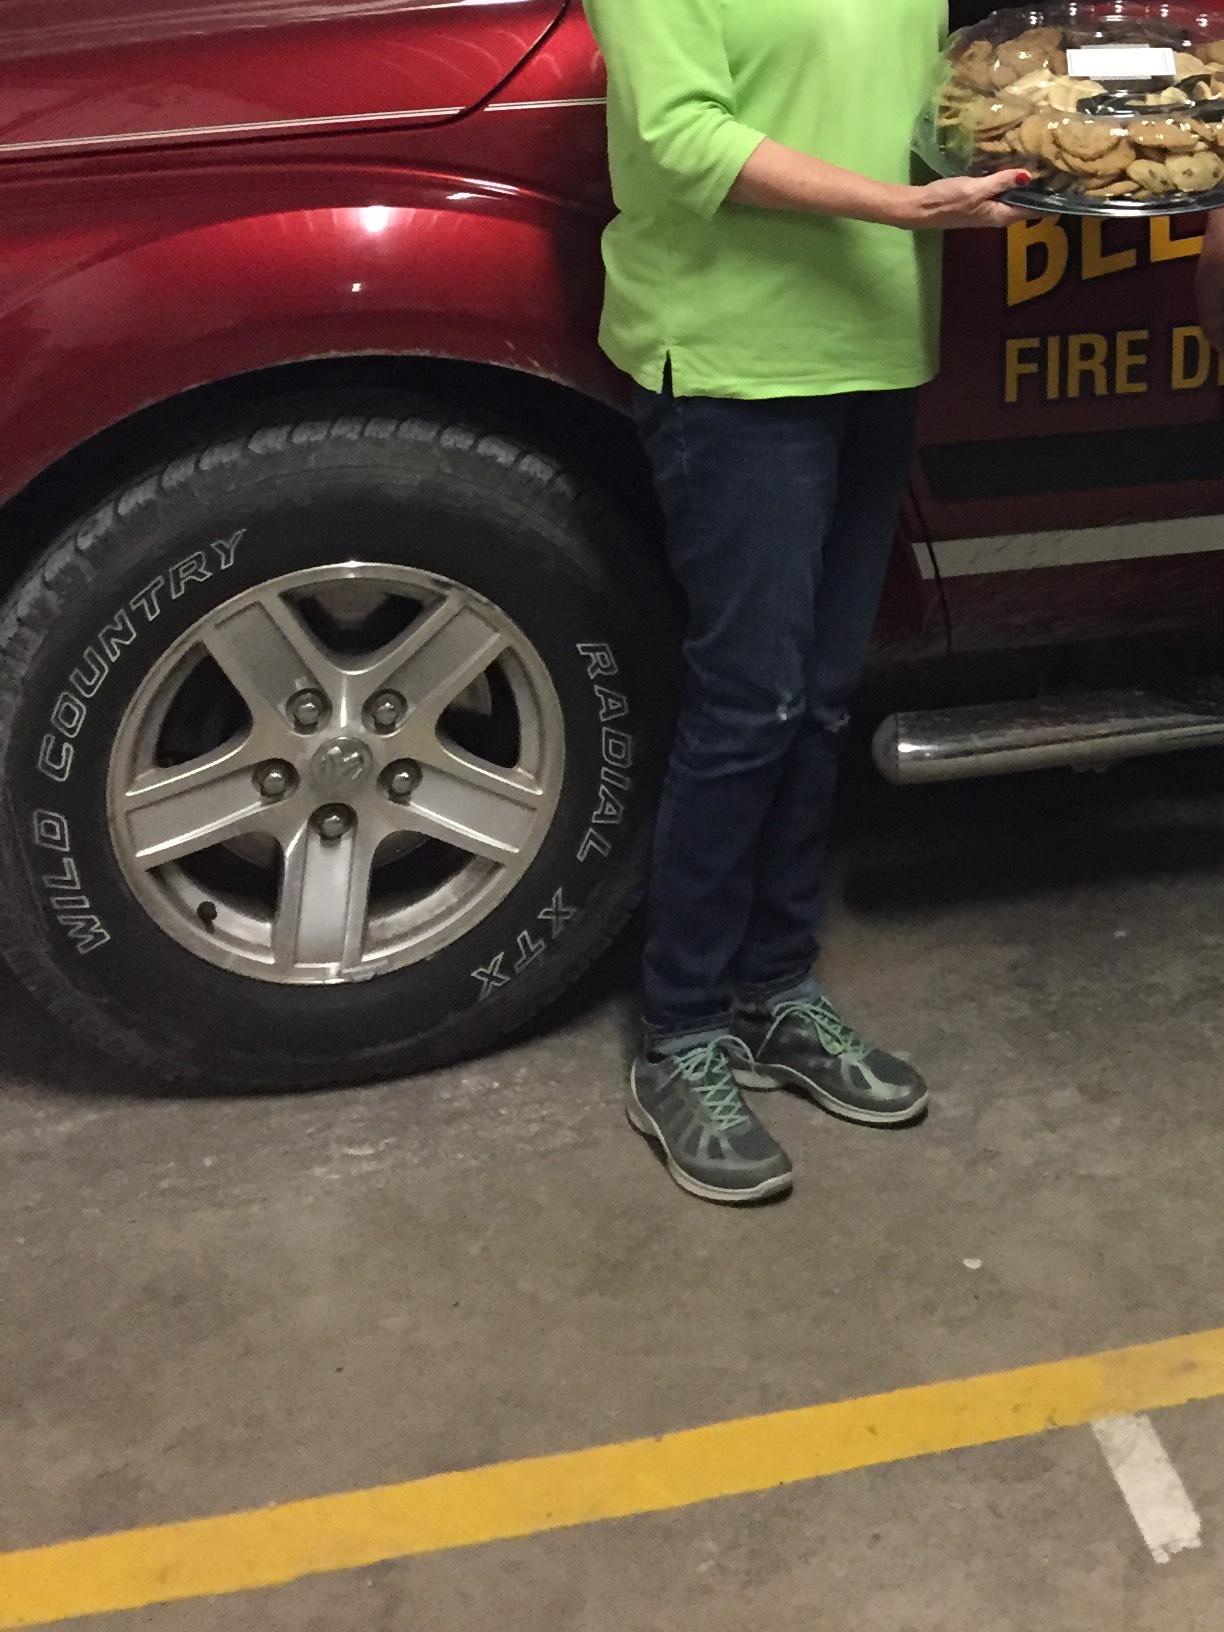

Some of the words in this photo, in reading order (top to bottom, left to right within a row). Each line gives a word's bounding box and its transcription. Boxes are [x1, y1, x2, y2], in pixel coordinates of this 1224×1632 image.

[1004, 329, 1149, 403] FIRE
[37, 528, 247, 783] COUNTRY
[576, 642, 632, 863] RADIAL
[33, 809, 112, 955] WILD
[470, 886, 577, 1003] XTX
